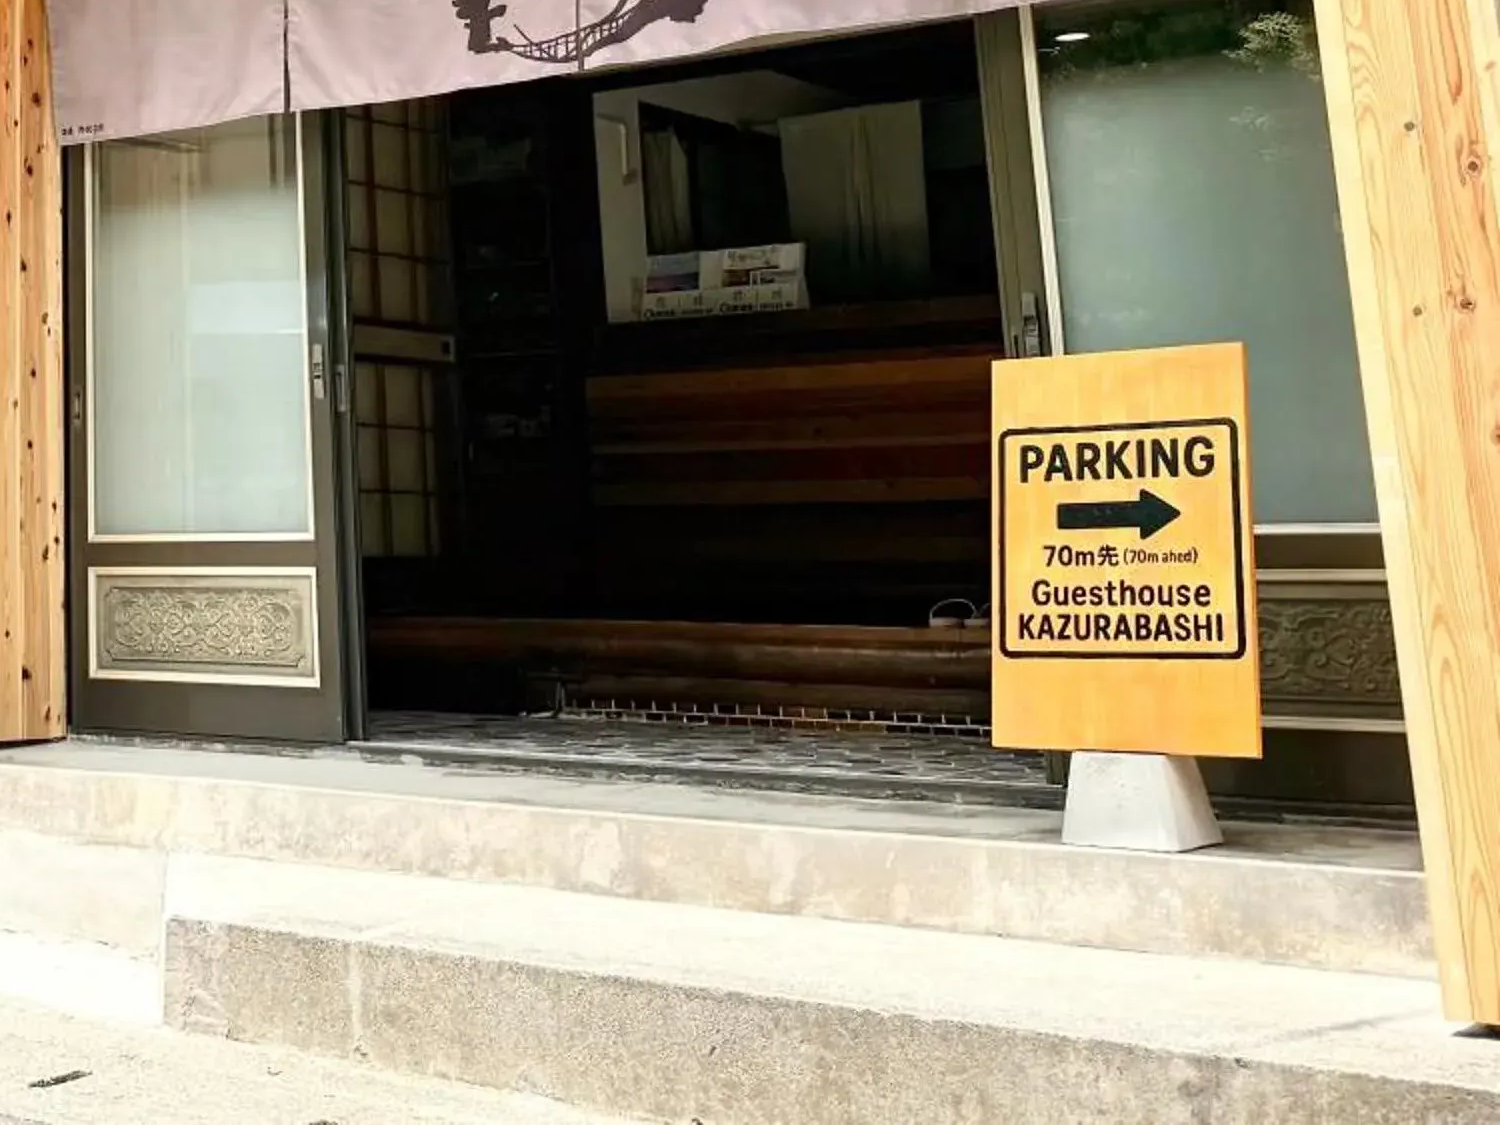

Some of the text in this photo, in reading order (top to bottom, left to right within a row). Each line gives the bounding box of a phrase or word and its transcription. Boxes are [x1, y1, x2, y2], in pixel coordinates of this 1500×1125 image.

[1019, 436, 1216, 483] PARKING
[1043, 544, 1120, 567] 70m先
[1123, 547, 1159, 565] (70m
[1031, 579, 1211, 608] Guesthouse
[1018, 613, 1224, 642] KAZURABASHI
